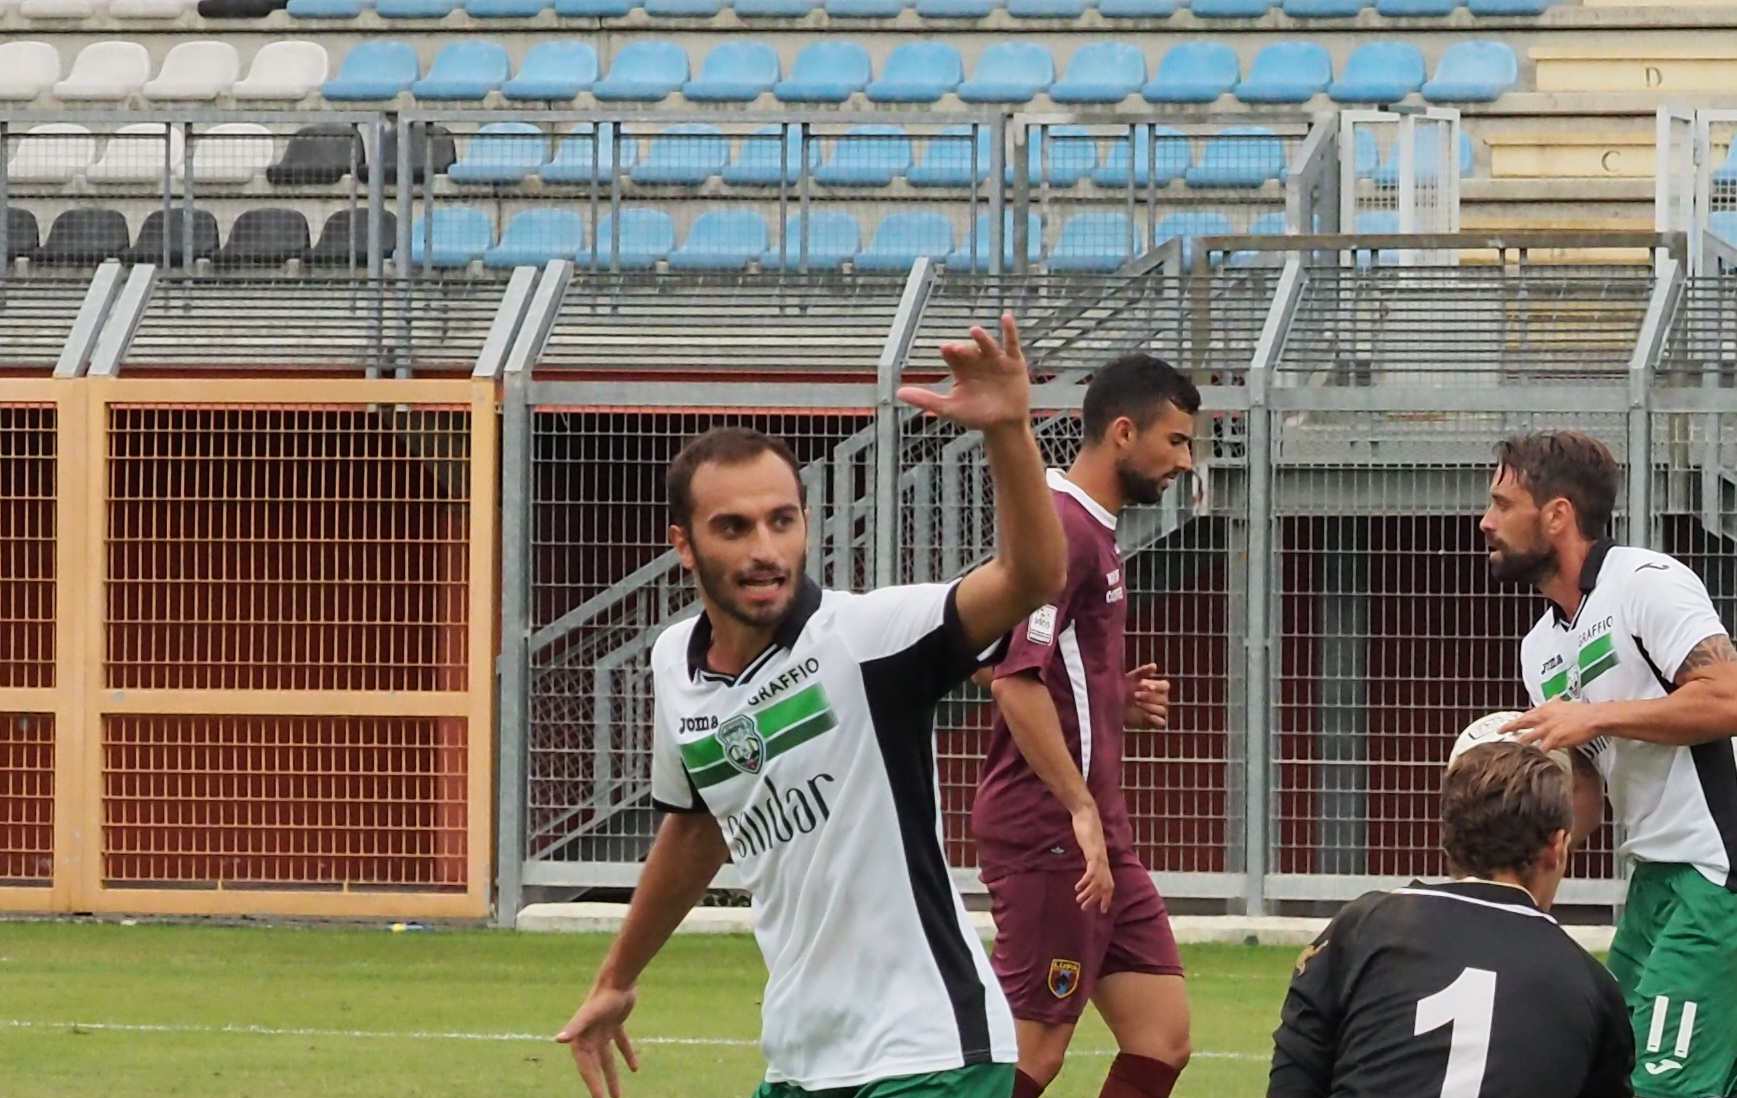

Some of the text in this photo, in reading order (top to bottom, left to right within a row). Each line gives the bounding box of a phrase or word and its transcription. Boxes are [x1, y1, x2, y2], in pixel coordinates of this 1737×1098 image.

[1645, 67, 1663, 88] D
[1601, 150, 1620, 172] C
[747, 657, 819, 706] GRAFFIO
[1646, 995, 1697, 1058] 11
